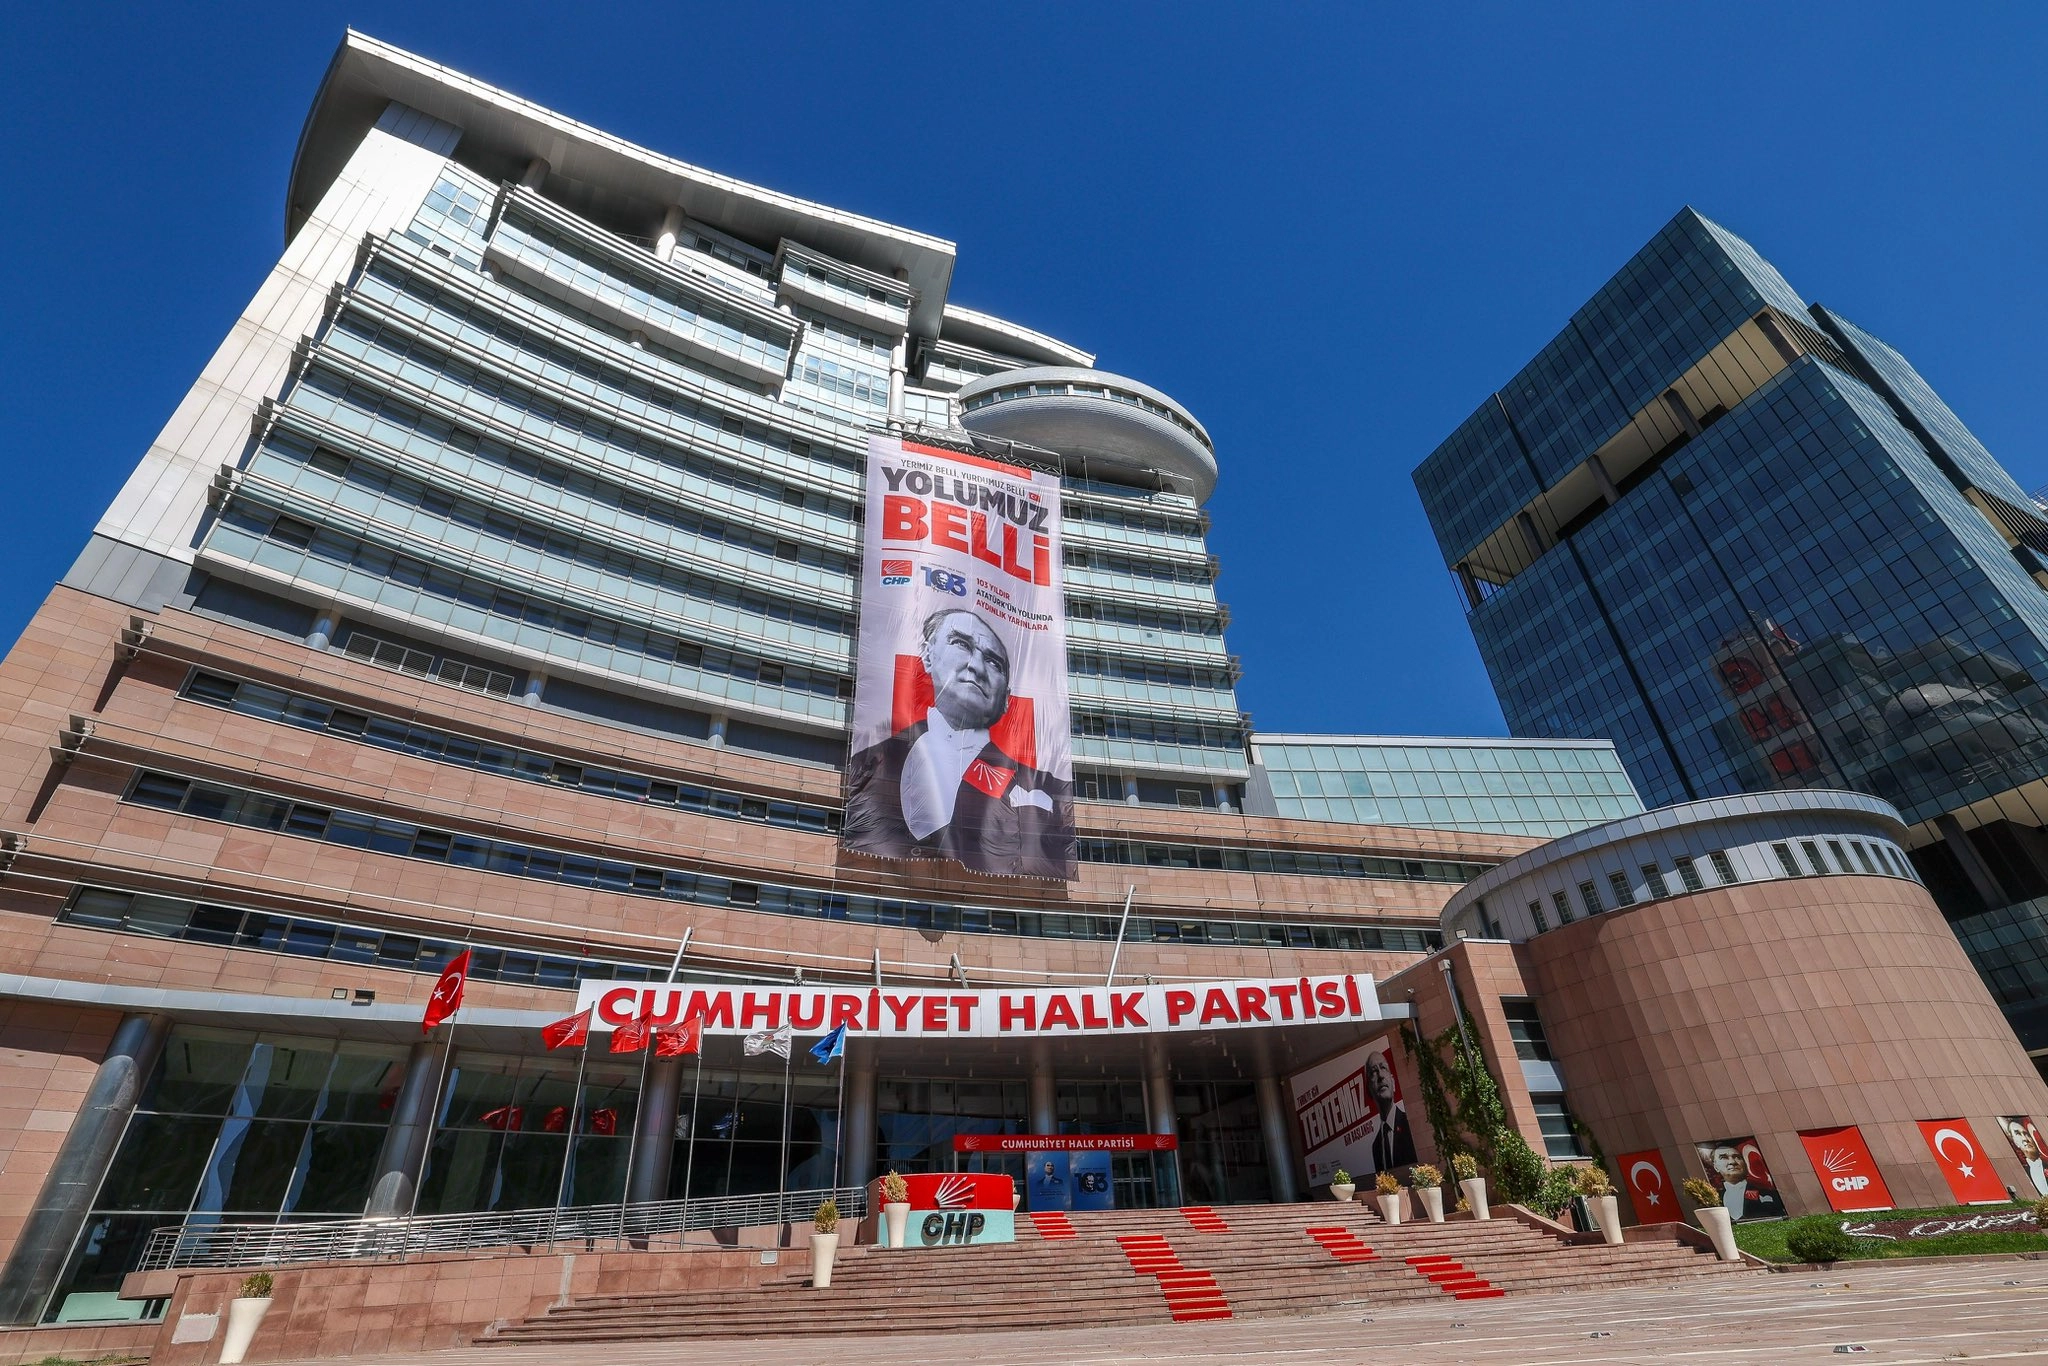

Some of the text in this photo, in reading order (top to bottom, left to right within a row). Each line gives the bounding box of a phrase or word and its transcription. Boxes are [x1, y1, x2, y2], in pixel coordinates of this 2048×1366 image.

[901, 459, 933, 472] YERİMİZ
[961, 472, 1005, 489] YURDUMUZ
[1006, 483, 1025, 496] BELLİ
[881, 466, 1049, 534] YOLUMUZ
[882, 495, 1050, 587] BELLİ
[882, 576, 911, 586] CHP
[976, 578, 1010, 600] 103 YILDIR
[976, 590, 1017, 615] ATATÜRK'ÜN
[1017, 607, 1053, 622] YOLUNDA
[976, 600, 1048, 631] AYDINLIK YARINLARA
[598, 974, 1362, 1032] CUMHURİYET HALK PARTİSİ
[1300, 1073, 1370, 1149] TERTEMİZ
[1001, 1136, 1134, 1149] CUMHURİYET HALK PARTİSİ
[1831, 1175, 1870, 1192] CHP
[921, 1212, 985, 1239] CHP
